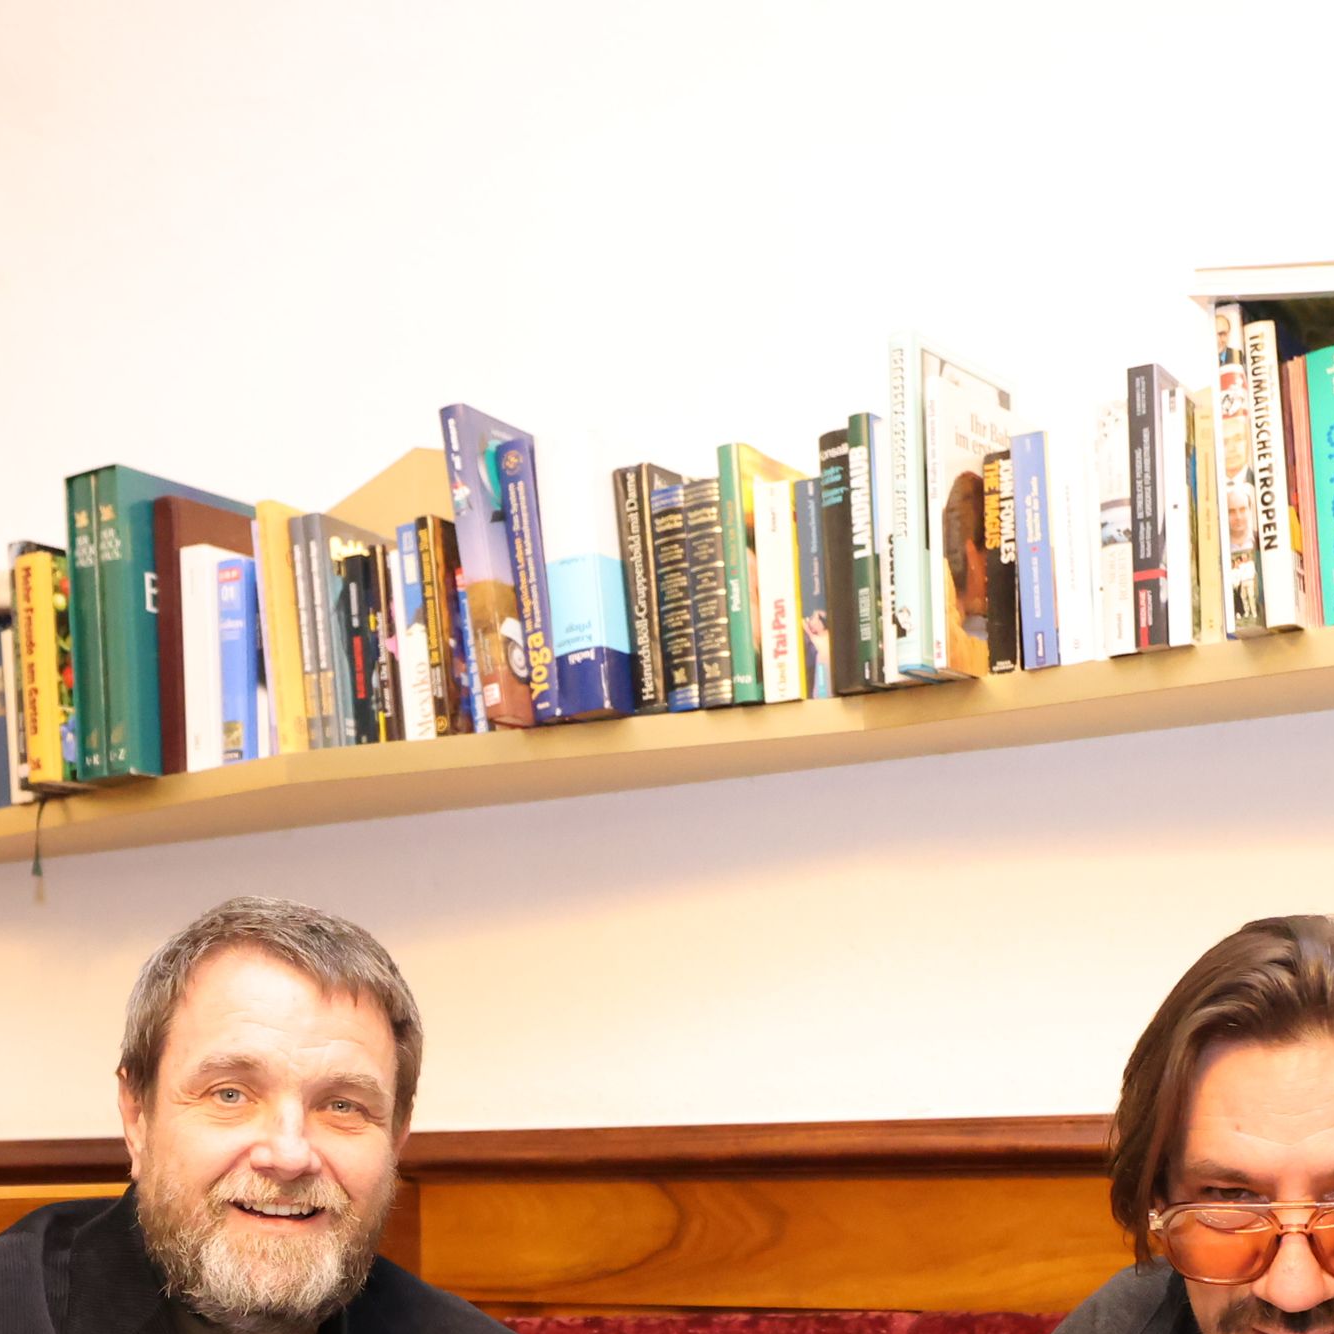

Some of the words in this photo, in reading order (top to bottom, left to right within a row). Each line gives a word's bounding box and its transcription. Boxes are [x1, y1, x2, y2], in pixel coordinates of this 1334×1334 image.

[1248, 331, 1273, 461] TRAUMATISCHE
[954, 425, 969, 451] im
[970, 413, 987, 438] Ihr
[622, 471, 639, 511] Dame
[984, 458, 1000, 493] THE
[998, 457, 1014, 500] JOHN
[626, 512, 640, 534] mit
[846, 445, 874, 559] LANDRAUB
[984, 496, 1002, 551] MAGUS
[1257, 463, 1278, 550] TROPEN
[998, 498, 1016, 565] FOWLES
[20, 566, 34, 603] Mehr
[626, 534, 650, 614] Gruppenbild
[22, 606, 36, 655] Freude
[635, 618, 650, 646] Böll
[768, 597, 789, 659] Tai-Pan
[26, 661, 37, 684] am
[523, 630, 556, 699] Yoga
[637, 645, 655, 699] Heinrich
[26, 686, 41, 736] Garten
[409, 660, 436, 736] Mexiko
